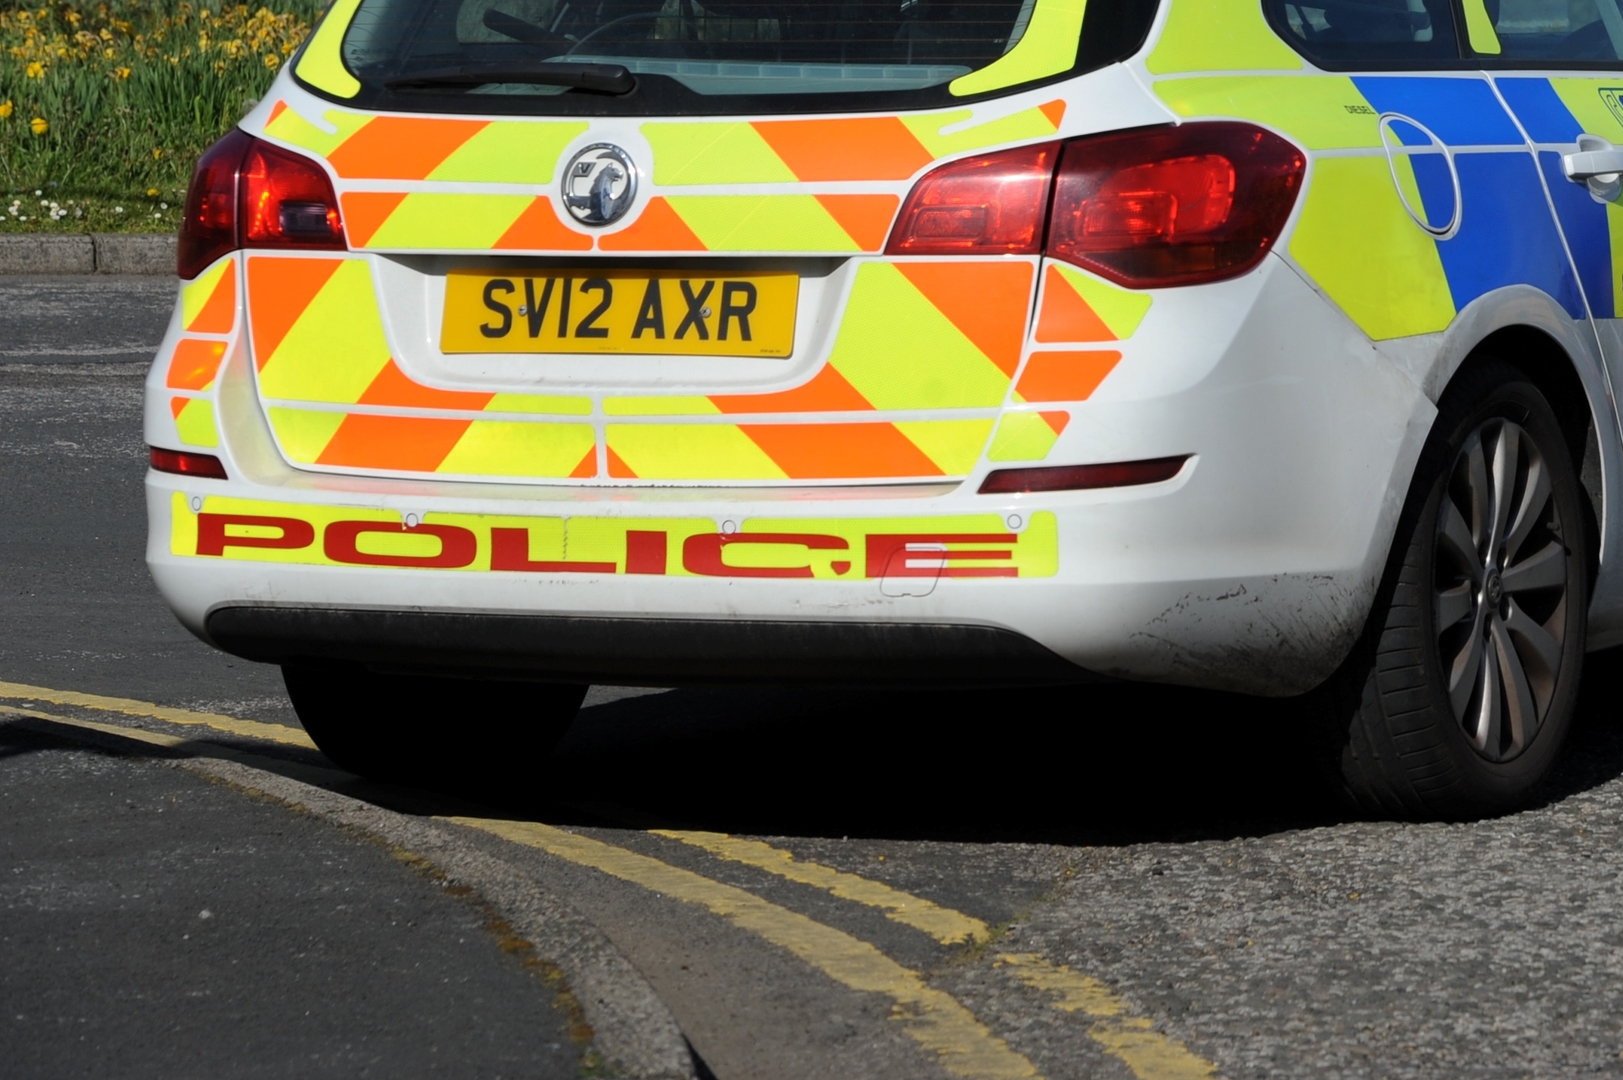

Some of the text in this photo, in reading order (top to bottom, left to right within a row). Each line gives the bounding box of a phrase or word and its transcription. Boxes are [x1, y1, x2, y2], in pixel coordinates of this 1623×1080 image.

[479, 278, 758, 342] SV12 AXR
[195, 512, 1019, 579] POLICE
